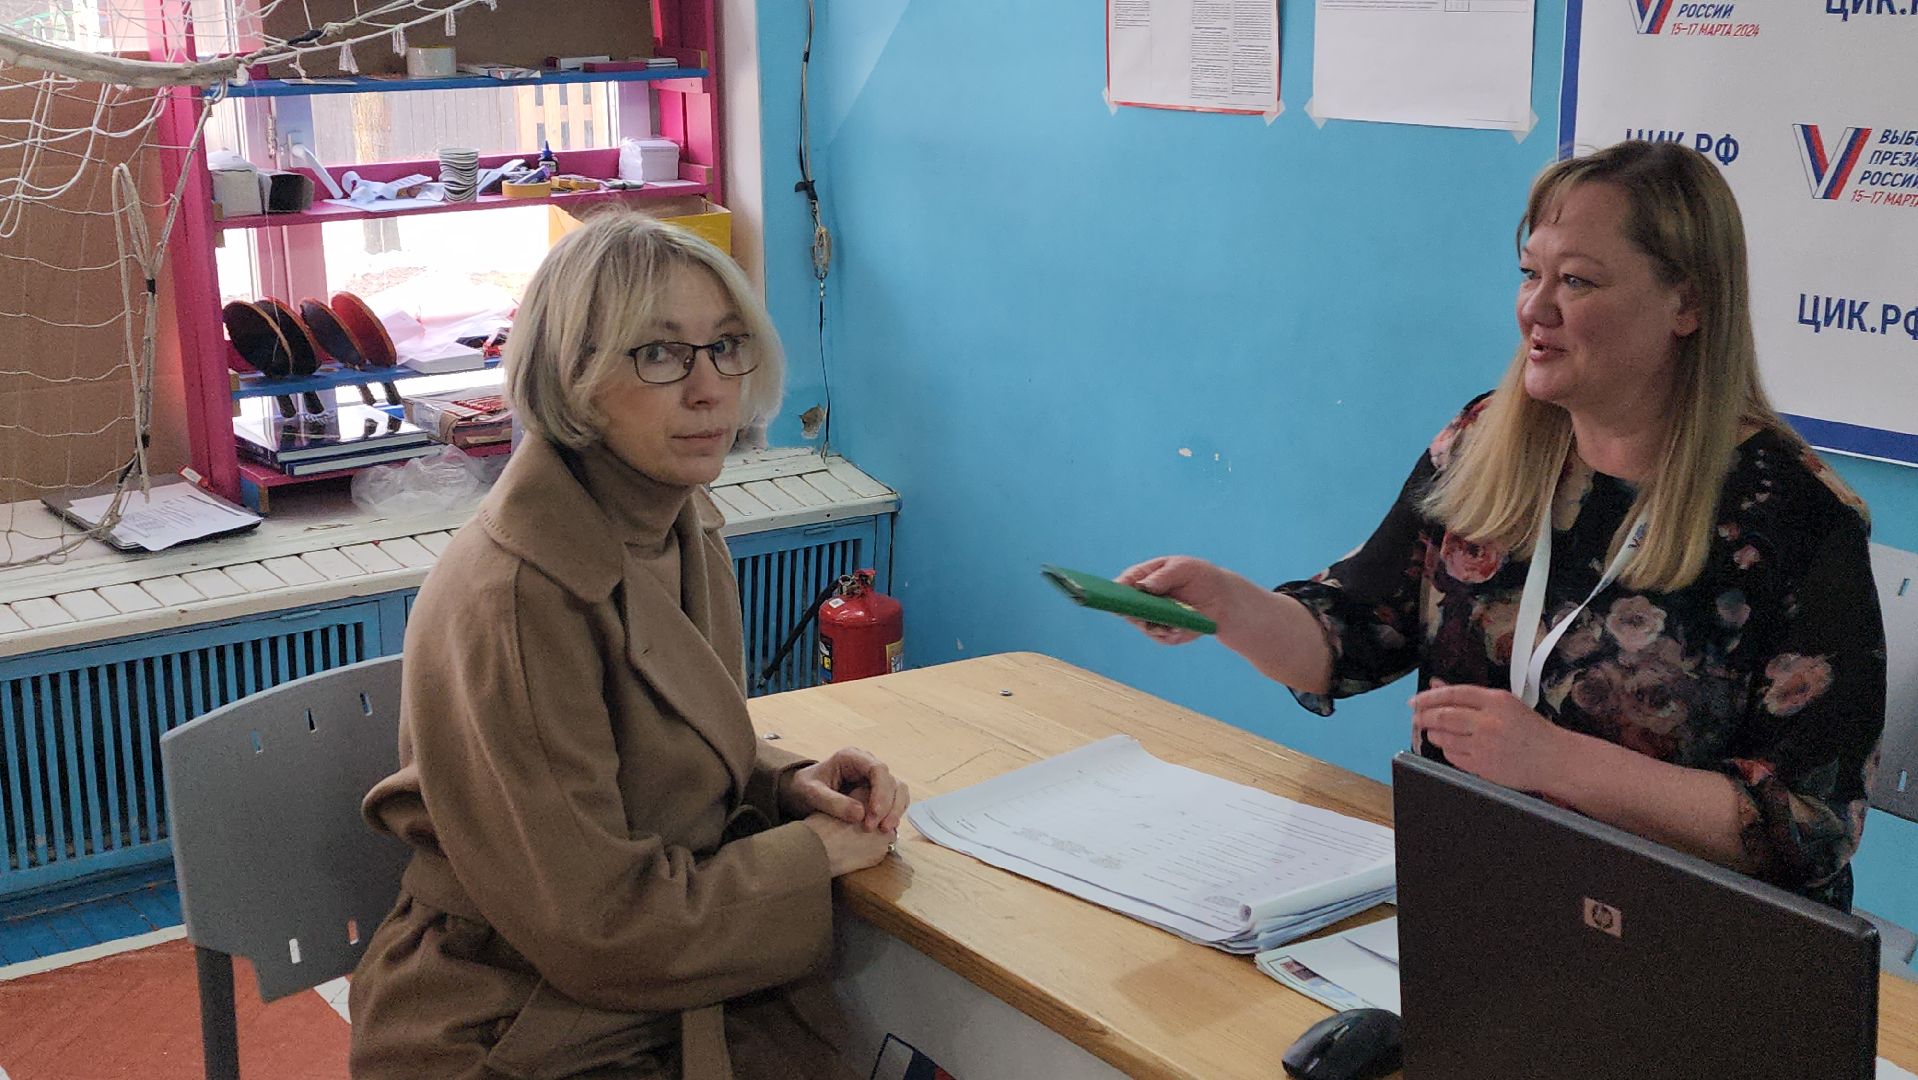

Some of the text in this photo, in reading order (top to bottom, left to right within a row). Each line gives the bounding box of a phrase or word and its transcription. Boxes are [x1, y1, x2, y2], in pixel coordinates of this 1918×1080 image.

[1677, 4, 1735, 19] РОССИИ
[1699, 23, 1732, 37] МАРТА
[1733, 24, 1760, 37] 2024
